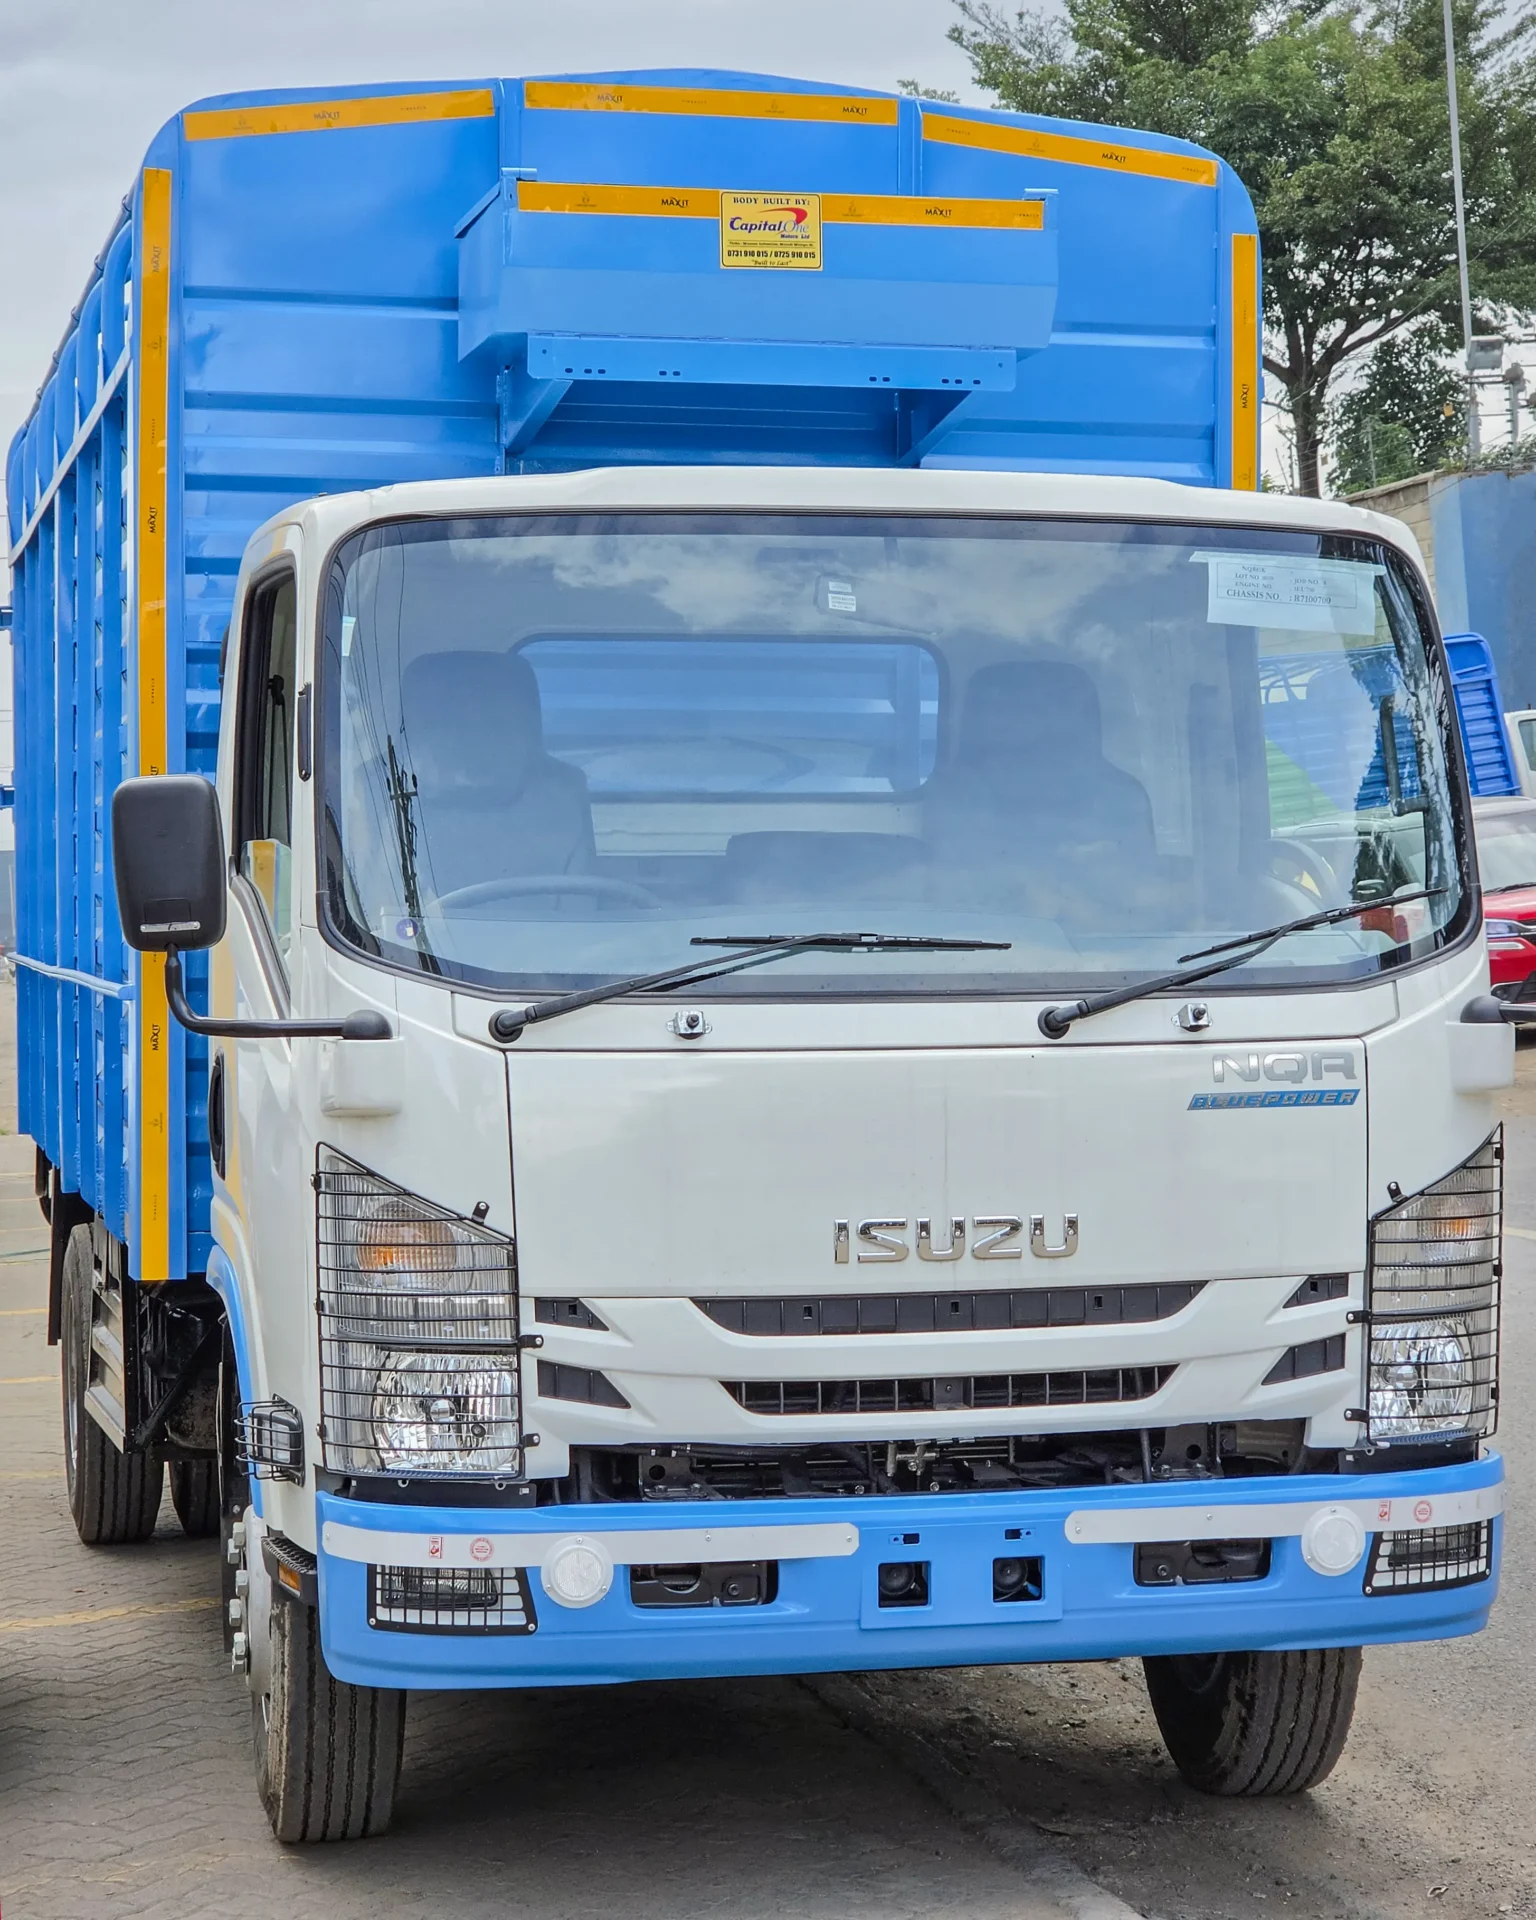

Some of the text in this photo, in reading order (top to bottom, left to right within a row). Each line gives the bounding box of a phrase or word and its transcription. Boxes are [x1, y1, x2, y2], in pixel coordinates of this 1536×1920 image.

[842, 105, 869, 115] MAXIT
[1101, 152, 1127, 163] MAXIT
[661, 196, 689, 208] MAXIT
[763, 197, 791, 205] BUILT
[795, 198, 810, 206] BY:
[925, 206, 952, 217] MAXIT
[756, 250, 768, 258] 015
[804, 251, 816, 259] 015
[1240, 384, 1250, 408] MAXIT
[148, 506, 157, 534] MAXIT
[1227, 588, 1264, 599] CHASSIS
[150, 1023, 161, 1051] MAXIT
[1212, 1052, 1357, 1084] NQR
[1188, 1090, 1359, 1110] BLUEPOWER
[834, 1213, 1079, 1263] ISUZU
